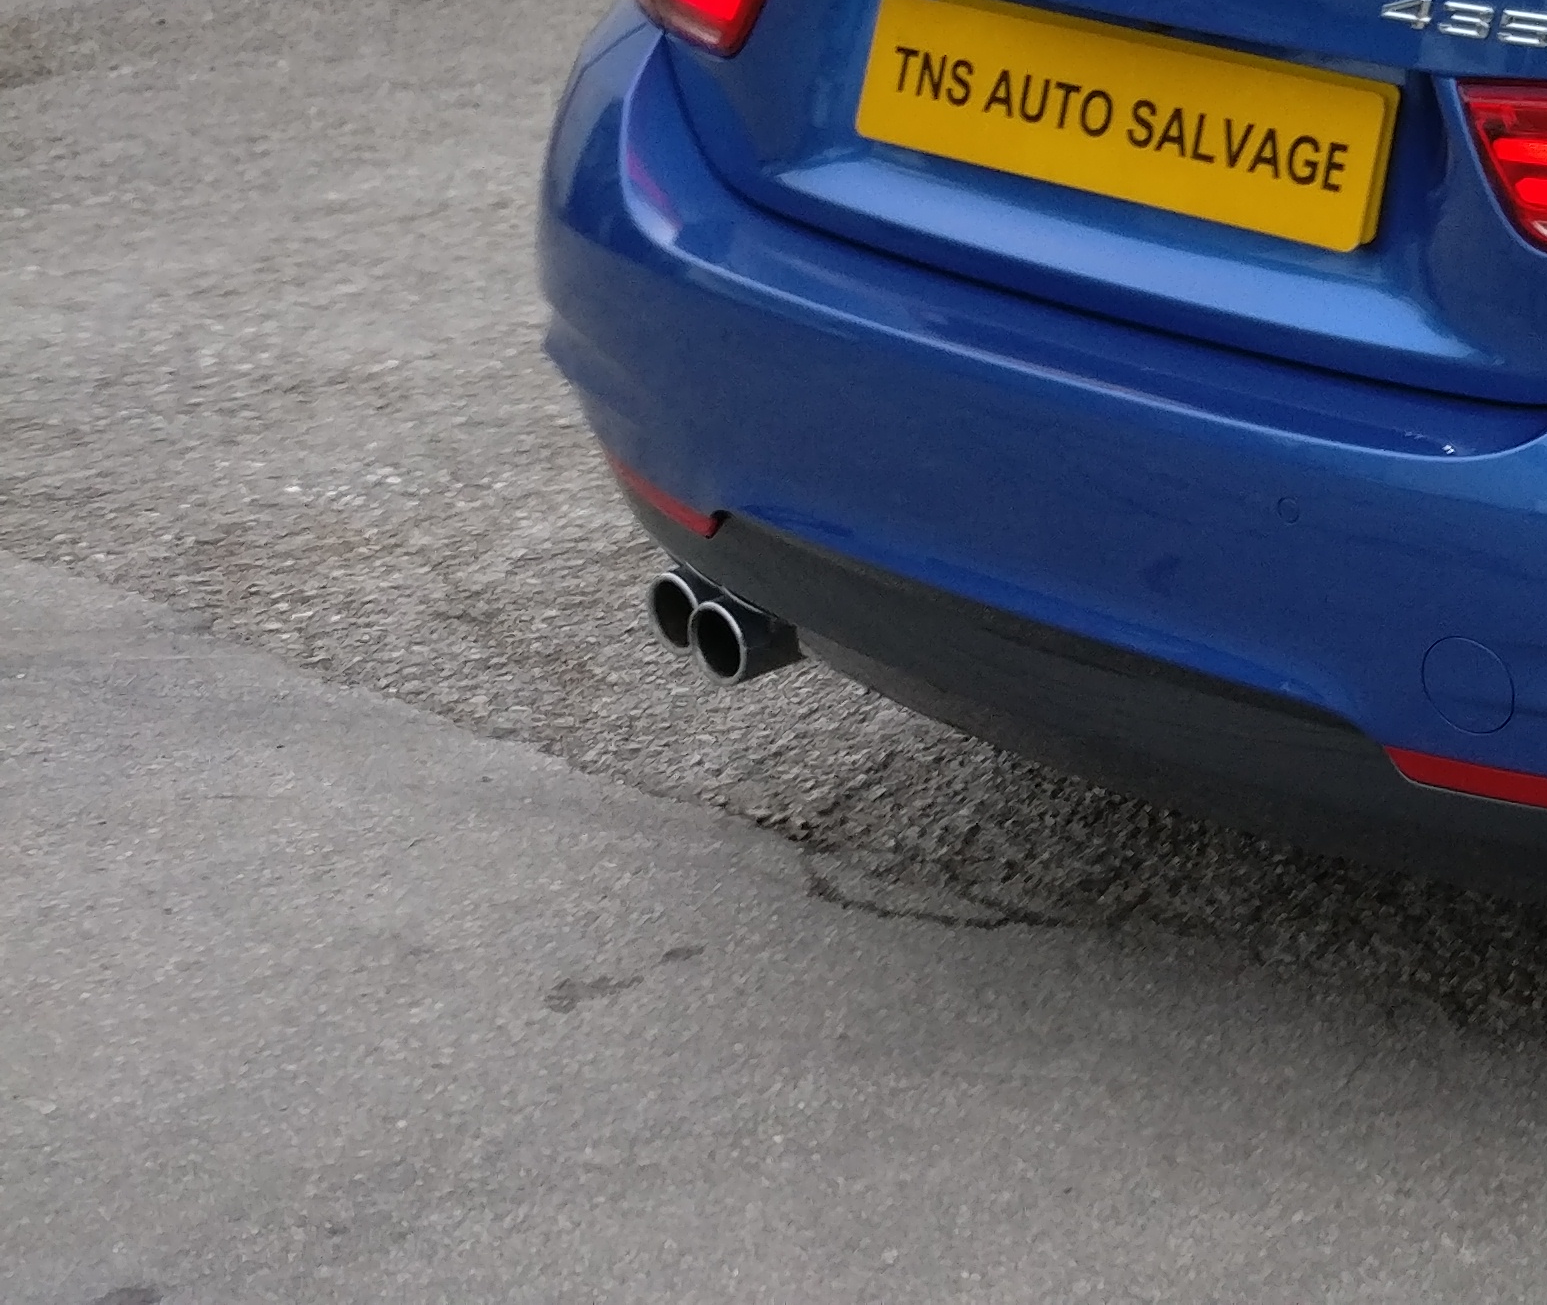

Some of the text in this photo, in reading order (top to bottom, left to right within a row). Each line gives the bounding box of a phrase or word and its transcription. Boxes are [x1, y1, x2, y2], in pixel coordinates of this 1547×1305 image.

[895, 45, 1349, 193] TNS AUTO SALVAGE
